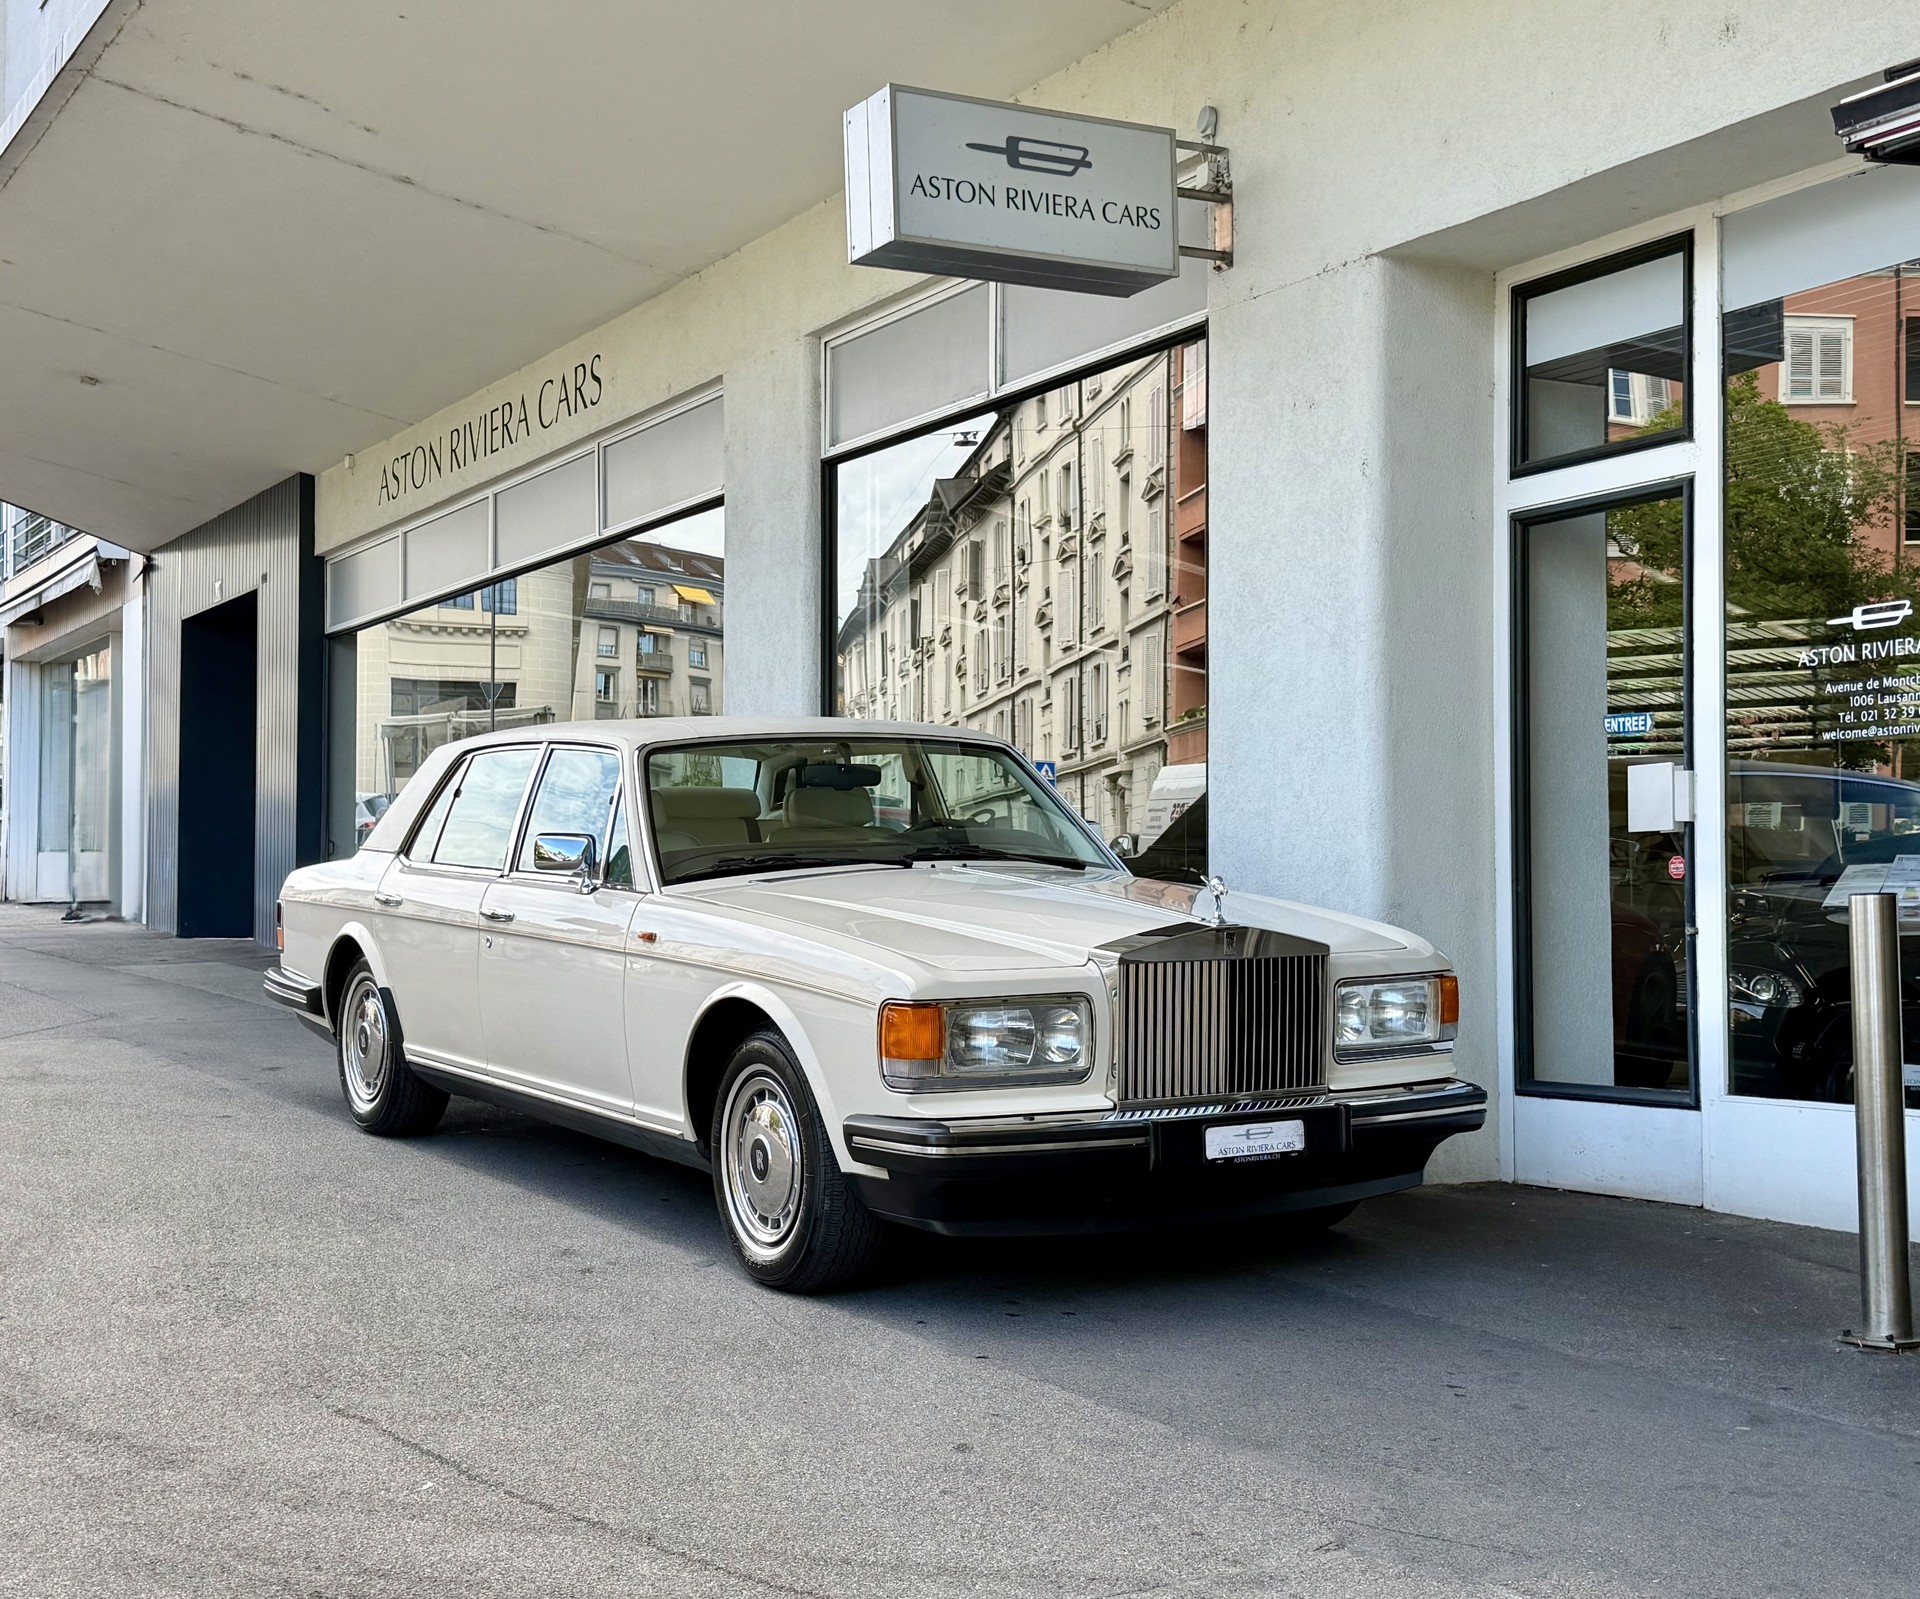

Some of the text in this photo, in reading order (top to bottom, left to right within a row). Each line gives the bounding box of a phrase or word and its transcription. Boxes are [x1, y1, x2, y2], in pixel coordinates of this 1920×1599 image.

[910, 173, 1161, 230] ASTON RIVIERA CARS
[378, 354, 602, 506] ASTON RIVIERA CARS
[1797, 644, 1855, 667] ASTON
[1825, 682, 1863, 694] Avenue
[1866, 678, 1879, 690] de
[1849, 694, 1874, 707] 1006
[1838, 711, 1857, 723] Tél.
[1861, 709, 1878, 721] 021
[1883, 707, 1897, 720] 32
[1901, 706, 1915, 718] 39
[1604, 715, 1646, 732] ENTREE
[1218, 1141, 1296, 1156] ASTON RIVIERA CARS
[1233, 1153, 1281, 1163] ASTONRIVIERA.CH
